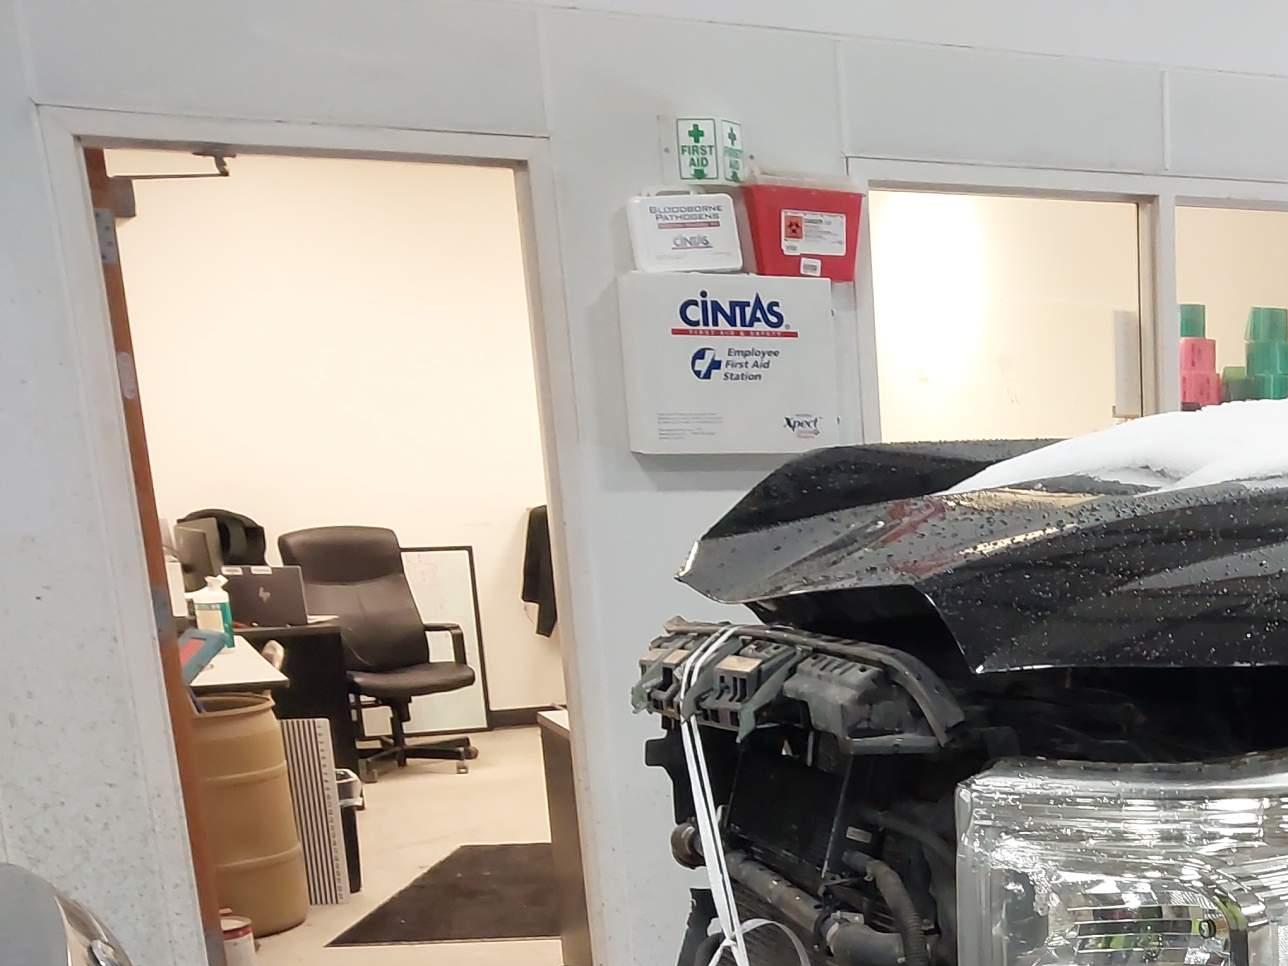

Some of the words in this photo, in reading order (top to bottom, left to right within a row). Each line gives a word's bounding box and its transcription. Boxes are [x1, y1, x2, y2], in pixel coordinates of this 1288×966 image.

[681, 145, 714, 156] FIRST
[689, 157, 709, 167] AID
[728, 347, 780, 360] Employee
[725, 360, 749, 369] First
[752, 360, 770, 369] Aid
[723, 372, 762, 381] Station
